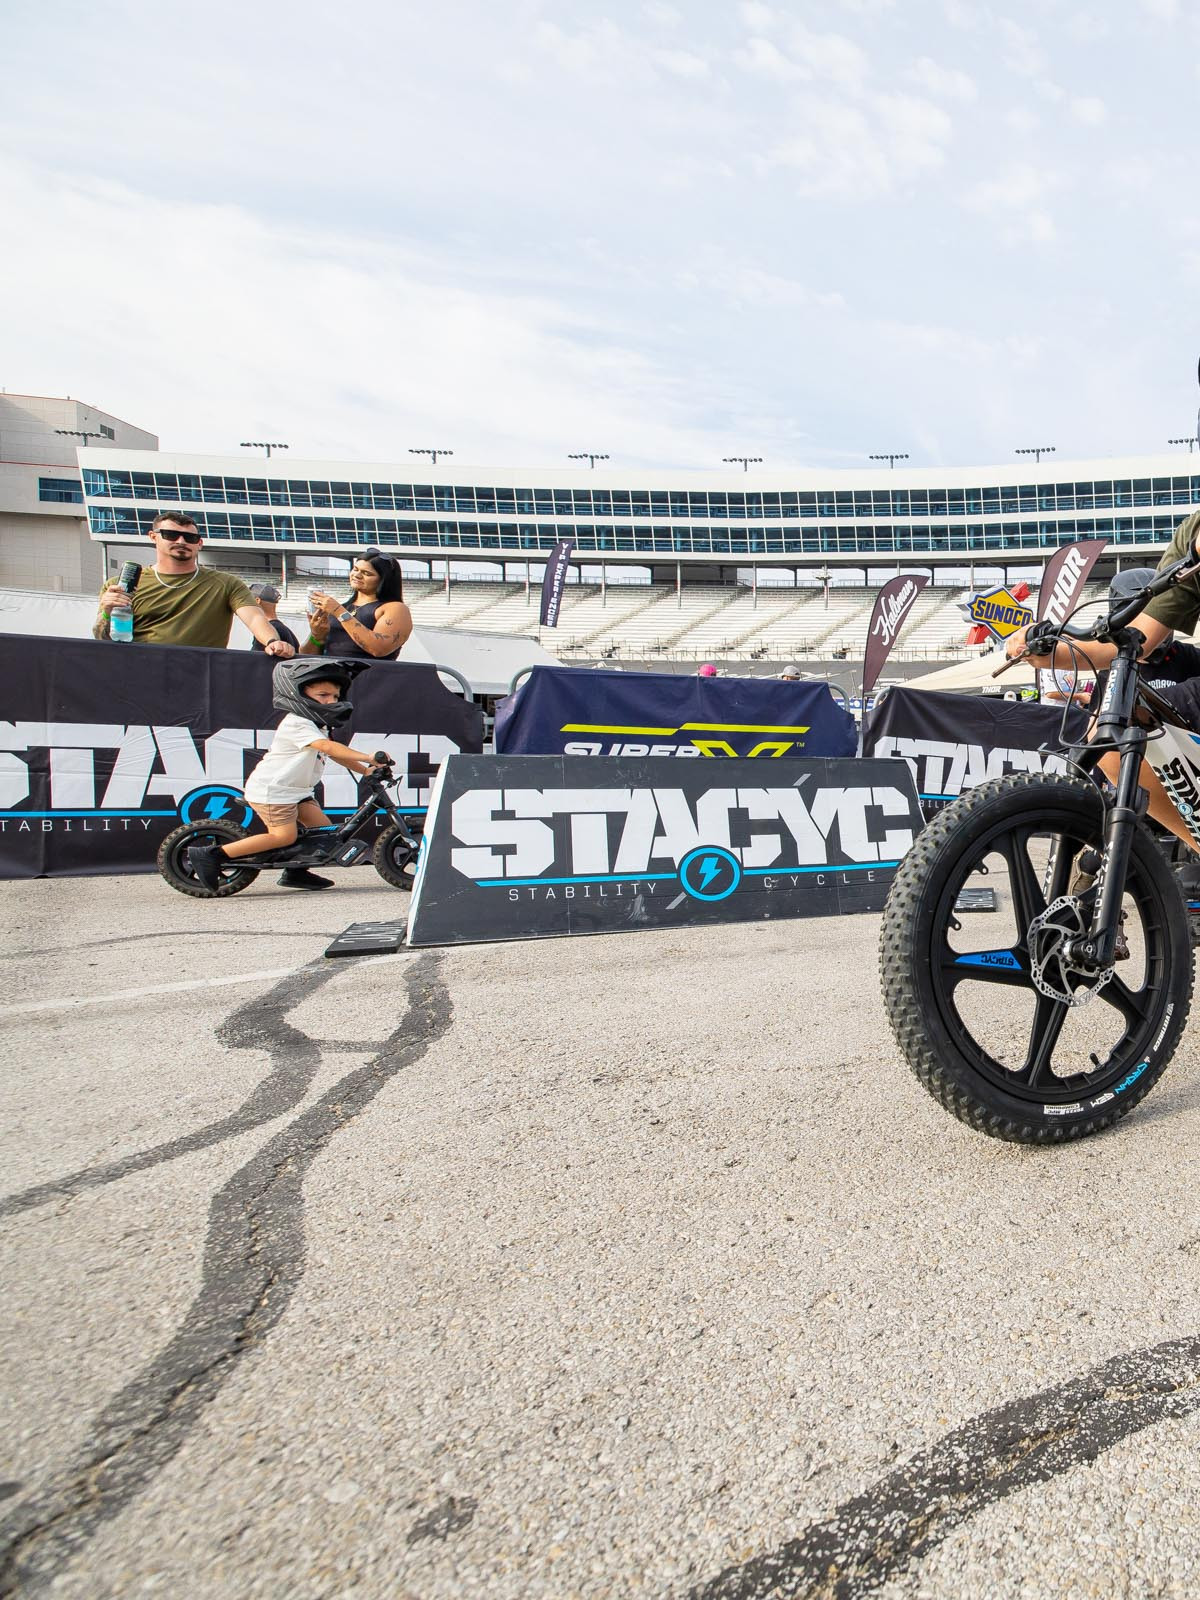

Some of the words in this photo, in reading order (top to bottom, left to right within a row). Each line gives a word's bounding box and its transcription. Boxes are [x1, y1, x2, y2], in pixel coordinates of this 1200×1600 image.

[558, 542, 569, 560] VIP
[1042, 547, 1089, 626] THOR
[871, 579, 918, 646] Hallman
[975, 600, 1032, 628] SUNOCO
[981, 686, 1002, 694] THOR
[451, 785, 915, 879] STACYC
[508, 882, 658, 901] STABILITY
[763, 870, 876, 888] CYCLE
[1114, 1062, 1148, 1094] CROWN
